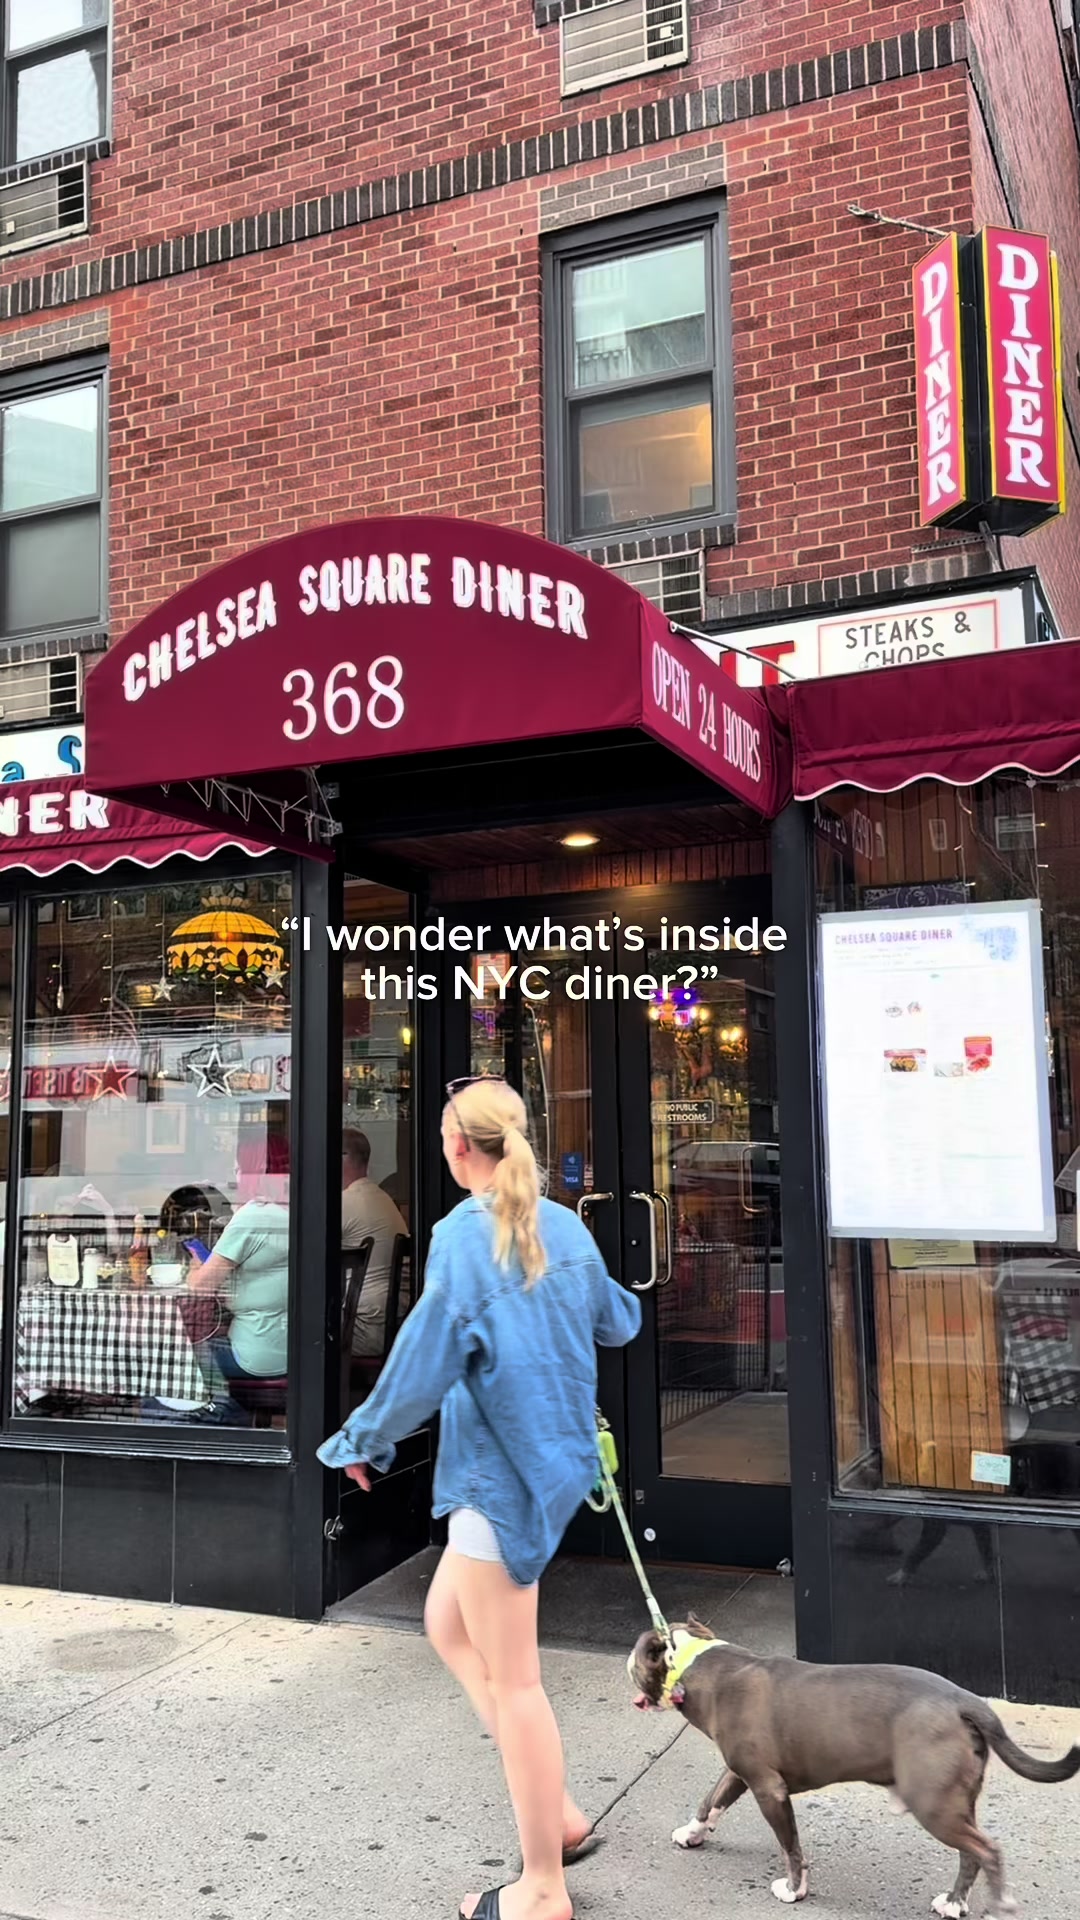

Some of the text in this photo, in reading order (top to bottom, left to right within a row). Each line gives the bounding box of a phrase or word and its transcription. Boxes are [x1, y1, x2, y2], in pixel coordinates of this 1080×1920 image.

[920, 261, 957, 506] DINER
[997, 243, 1051, 488] DINER
[122, 552, 588, 702] CHELSEA SQUARE DINER
[845, 611, 972, 650] STEAKS &
[864, 642, 945, 669] CHOPS
[282, 655, 405, 741] 368
[652, 641, 761, 783] OPEN 24 HOURS
[835, 928, 953, 945] CHELSEA SQUARE DINER
[676, 1103, 698, 1112] PUBLIC
